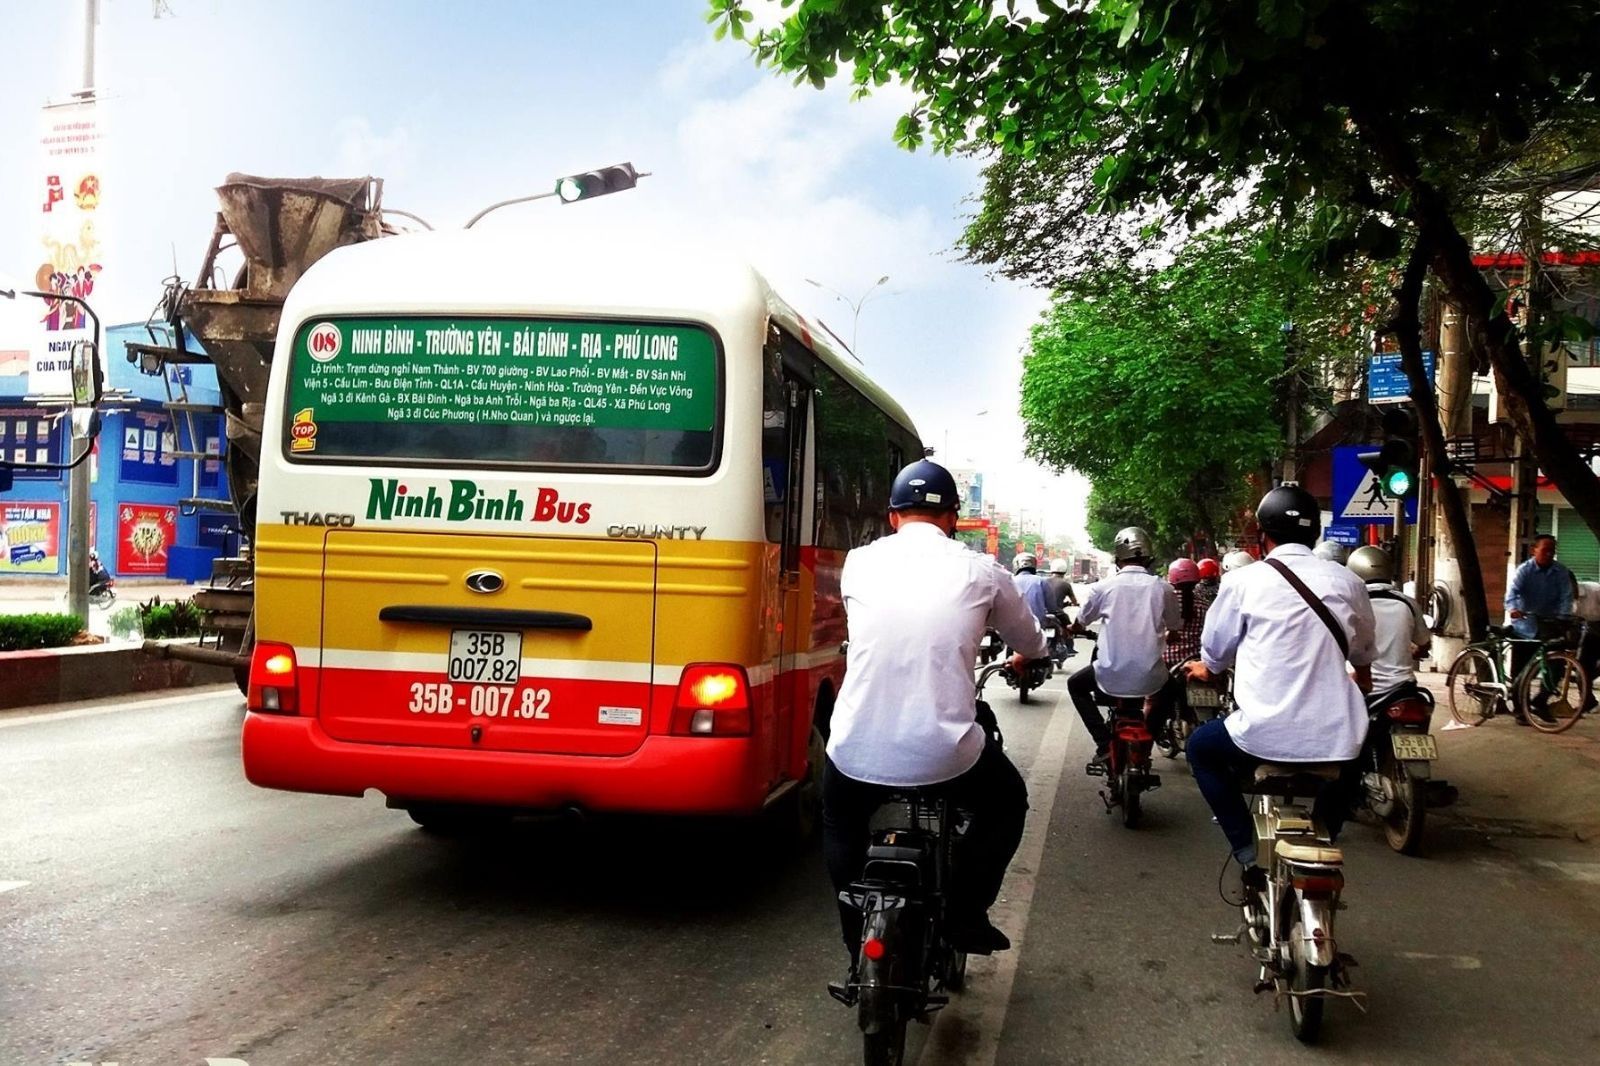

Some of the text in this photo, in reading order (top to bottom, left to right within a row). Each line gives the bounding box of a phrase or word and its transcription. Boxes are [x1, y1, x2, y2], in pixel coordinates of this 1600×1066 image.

[313, 332, 336, 352] 08
[352, 329, 382, 354] NINH
[384, 324, 414, 354] BÌNH
[425, 323, 474, 355] TRƯỜNG
[477, 325, 502, 356] YÊN
[513, 326, 535, 356] BÁI
[537, 326, 569, 357] ĐÍNH
[580, 333, 602, 363] RỊA
[614, 329, 641, 359] PHÚ
[643, 335, 678, 360] LONG
[311, 363, 321, 376] Lộ
[346, 363, 367, 376] Trạm
[412, 364, 431, 374] Nam
[467, 364, 480, 375] BV
[482, 365, 496, 375] 700
[536, 366, 549, 377] BV
[551, 366, 567, 377] Lao
[597, 368, 610, 378] BV
[636, 369, 649, 380] BV
[670, 370, 686, 381] Nhi
[304, 378, 320, 391] Viện
[352, 378, 368, 388] Lim
[393, 377, 412, 391] Điện
[440, 379, 464, 390] QL1A
[490, 380, 517, 393] Huyện
[524, 381, 545, 391] Ninh
[606, 383, 622, 394] Yên
[321, 392, 337, 405] Ngã
[397, 393, 410, 403] BX
[454, 394, 471, 407] Ngã
[473, 395, 484, 405] ba
[485, 395, 503, 405] Anh
[529, 396, 546, 409] Ngã
[548, 397, 559, 407] ba
[561, 397, 576, 410] Rịa
[583, 398, 607, 408] QL45
[614, 398, 626, 409] Xã
[628, 399, 645, 410] Phú
[648, 400, 671, 413] Long
[387, 408, 404, 420] Ngã
[423, 408, 440, 418] Cúc
[442, 409, 474, 422] Phương
[510, 410, 533, 421] Quan
[553, 413, 581, 425] ngược
[294, 425, 314, 435] TOP
[366, 478, 592, 524] Ninh Bình Bus
[280, 511, 355, 528] THACO
[607, 522, 707, 540] COUNTY
[467, 633, 504, 656] 35B
[450, 657, 517, 682] 007.82
